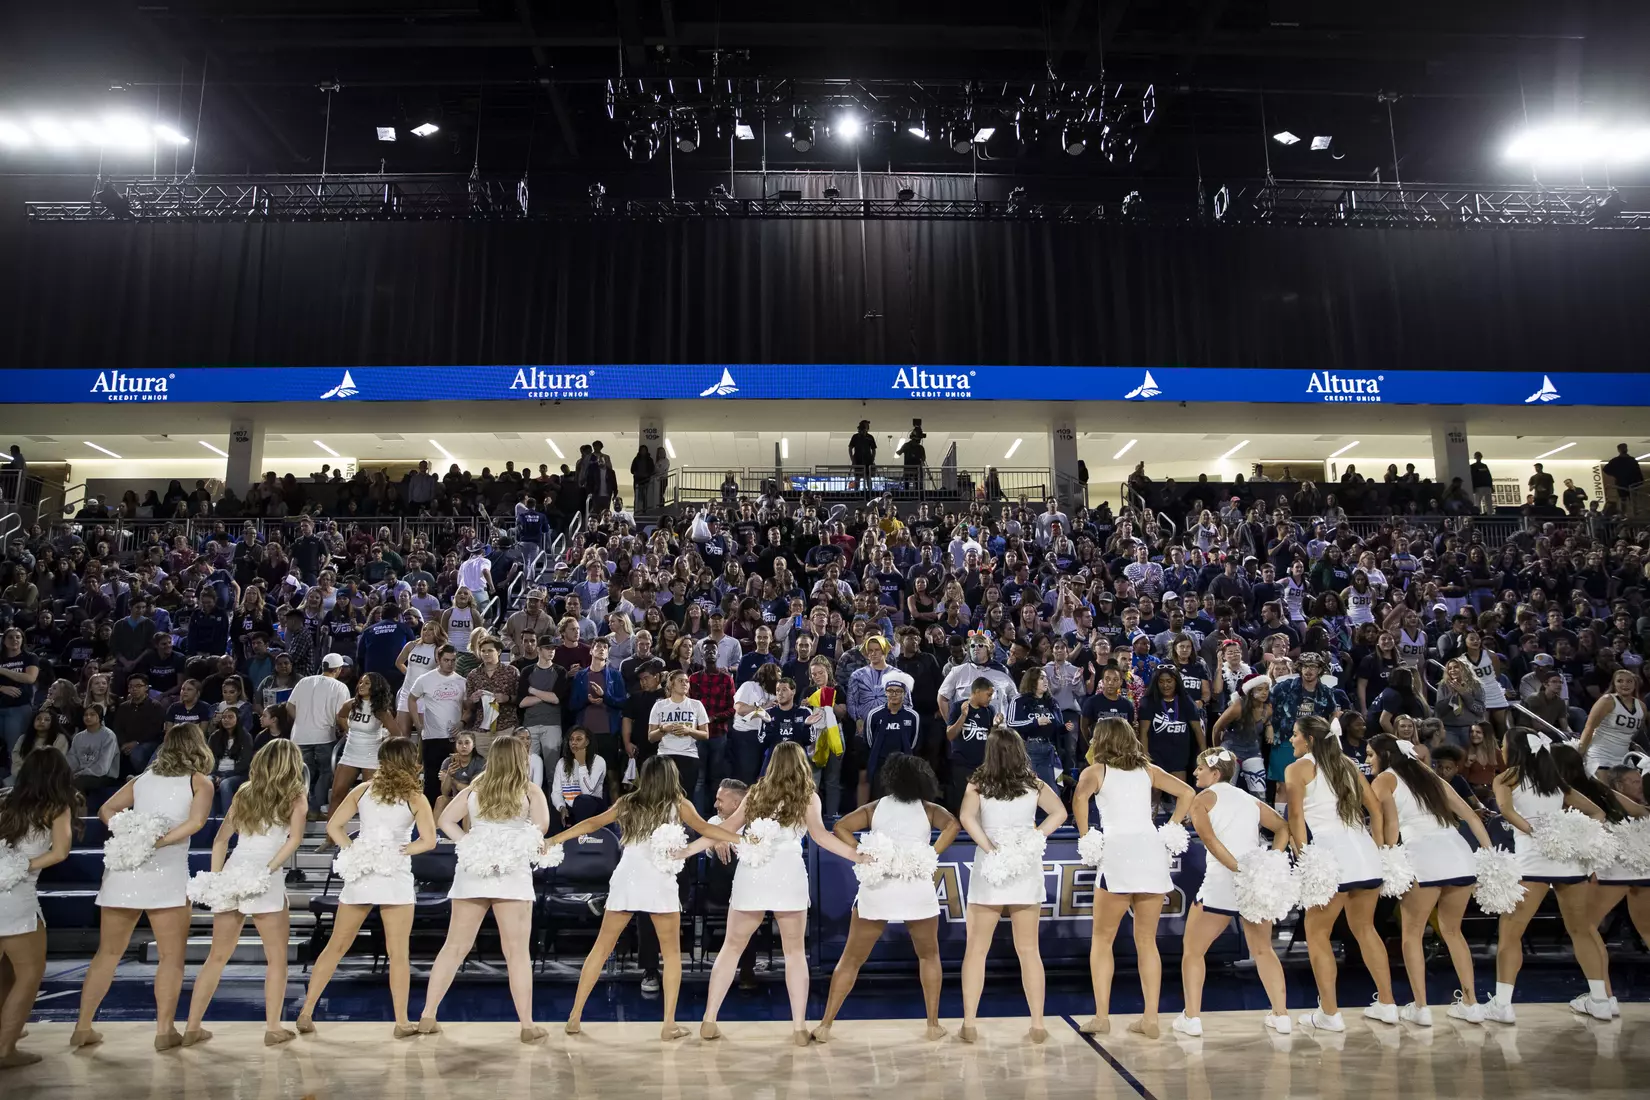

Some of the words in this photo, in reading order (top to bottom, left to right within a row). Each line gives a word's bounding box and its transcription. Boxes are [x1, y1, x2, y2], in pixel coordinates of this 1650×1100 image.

[346, 463, 355, 480] ME
[1592, 465, 1604, 503] WOMEN
[451, 620, 471, 628] CBU
[410, 653, 431, 665] CBU
[1183, 680, 1202, 690] CBU
[1167, 725, 1186, 733] CBU
[976, 731, 988, 740] CB
